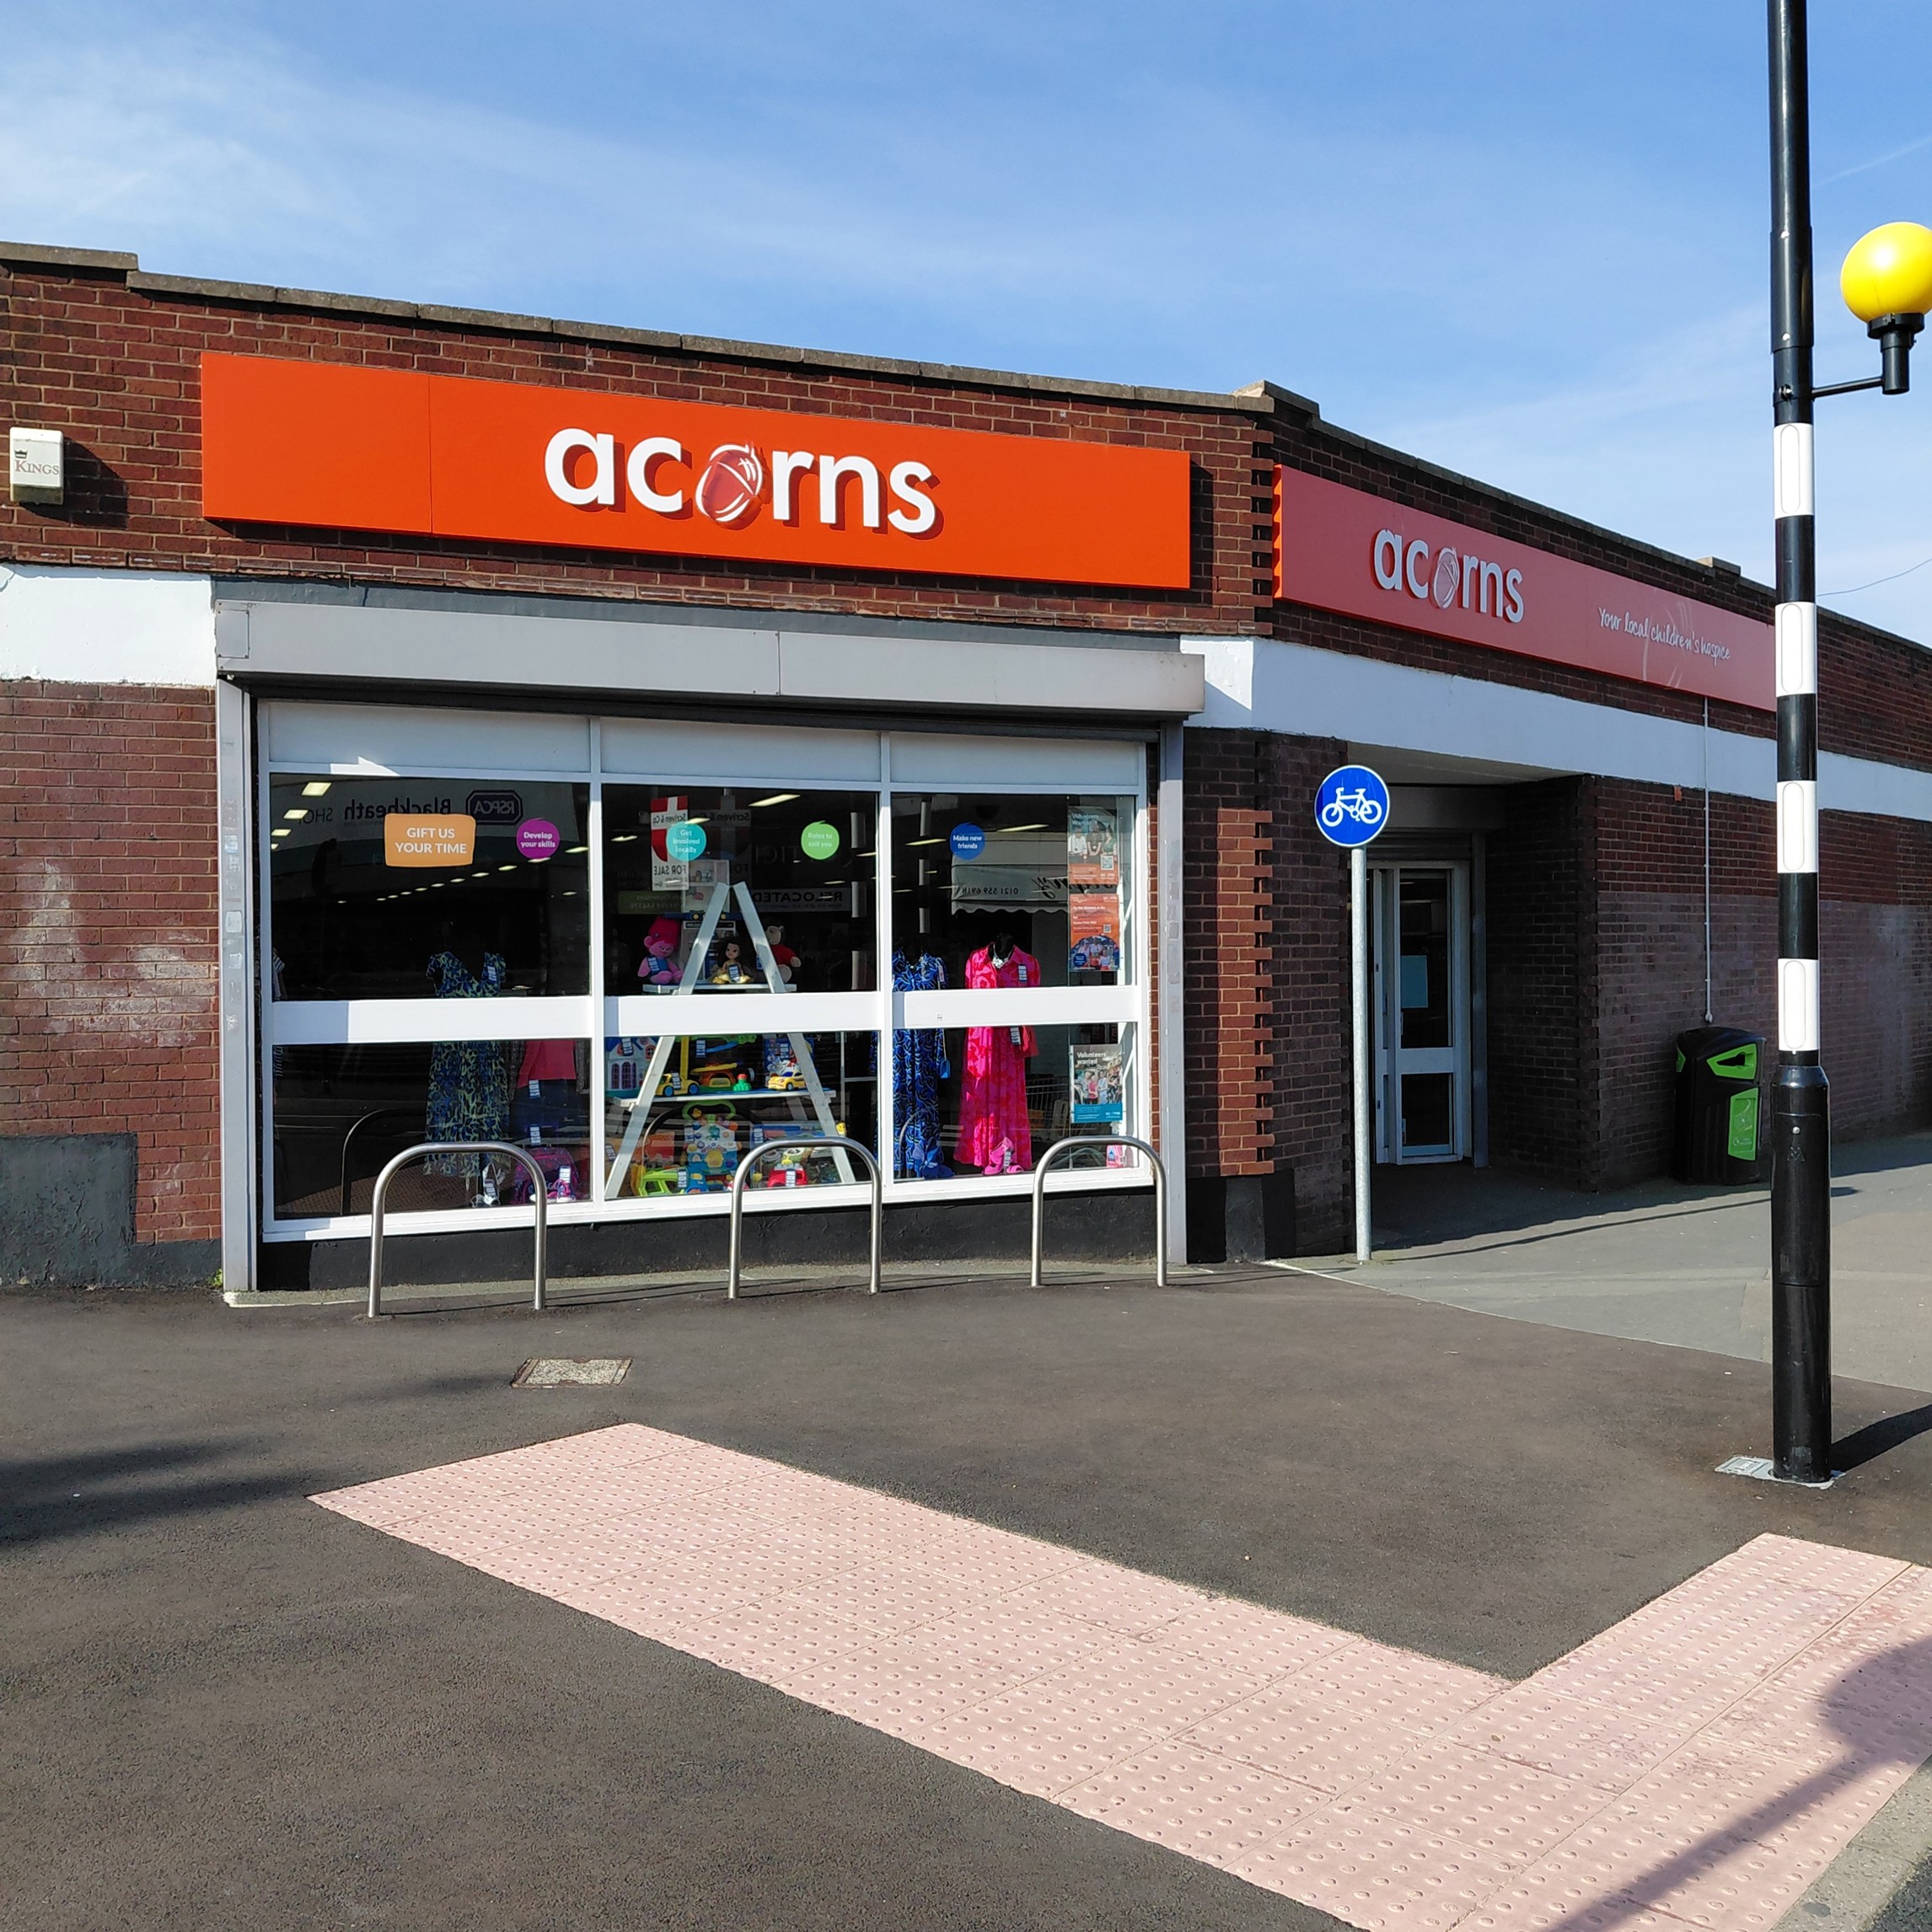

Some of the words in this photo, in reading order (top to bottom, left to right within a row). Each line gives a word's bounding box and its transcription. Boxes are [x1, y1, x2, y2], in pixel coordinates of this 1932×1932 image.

[14, 459, 60, 476] KINGS
[545, 427, 935, 534] acorns
[1374, 528, 1524, 623] acorns
[1598, 607, 1622, 631] Your
[1624, 612, 1649, 639] local
[1650, 623, 1699, 654] children's
[1700, 636, 1731, 666] hospice
[406, 827, 436, 839] GIFT
[438, 828, 455, 839] US
[523, 831, 553, 840] Develop
[394, 842, 432, 853] YOUR
[435, 843, 467, 854] TIME
